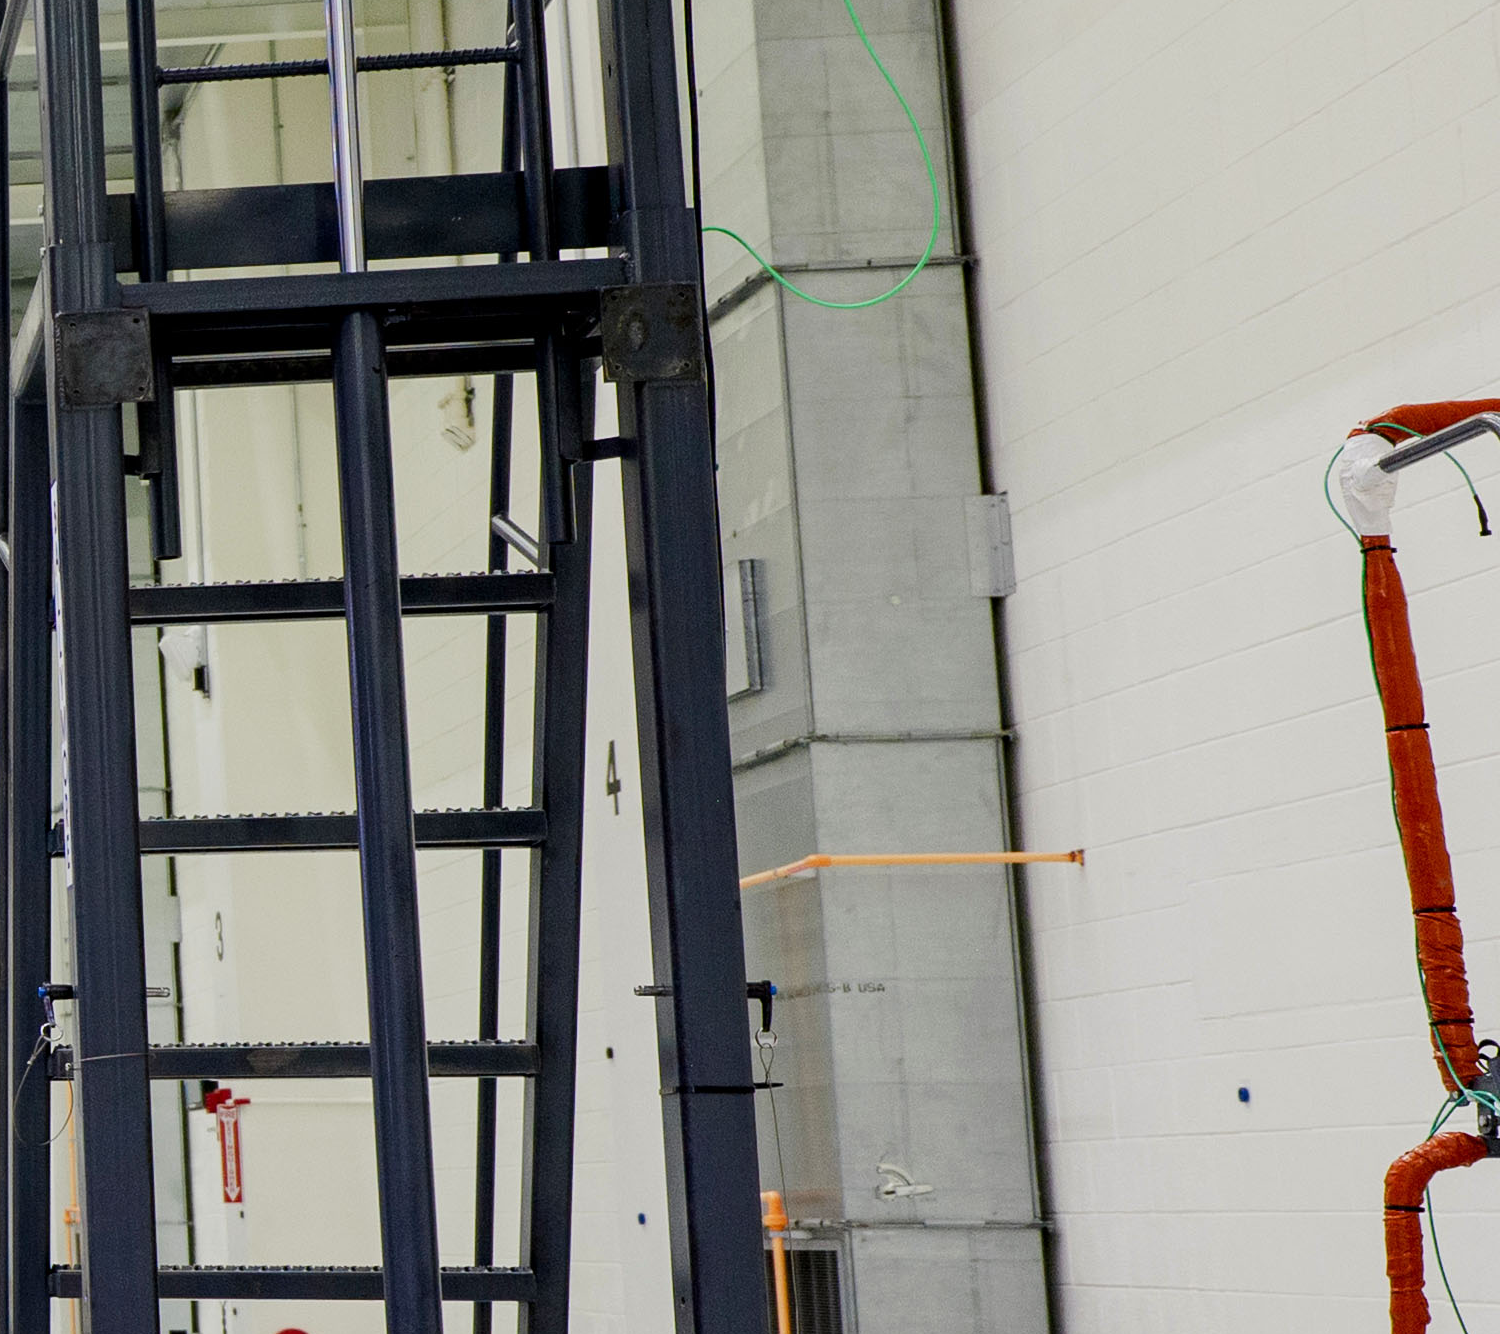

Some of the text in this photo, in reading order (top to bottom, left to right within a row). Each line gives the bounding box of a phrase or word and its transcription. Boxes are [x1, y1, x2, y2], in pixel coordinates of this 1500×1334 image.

[606, 739, 622, 816] 4
[214, 911, 225, 963] 3
[857, 983, 886, 993] USA
